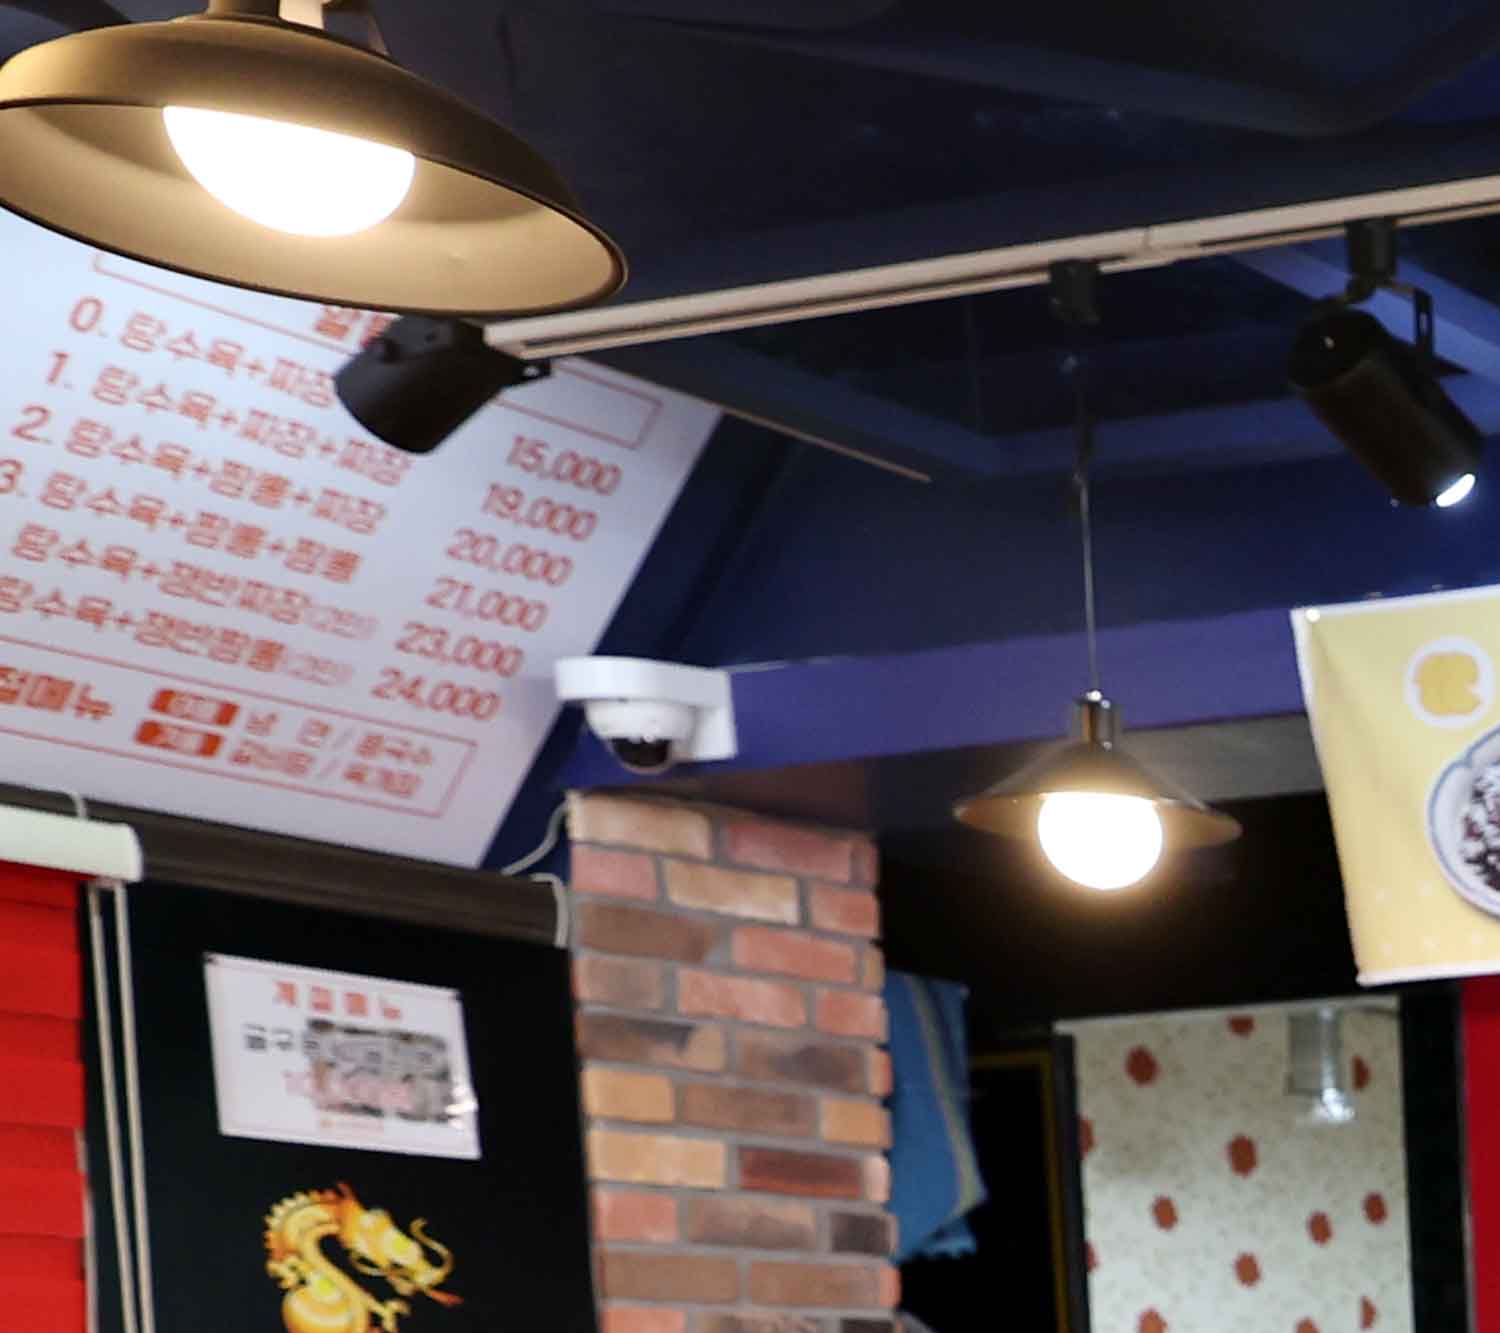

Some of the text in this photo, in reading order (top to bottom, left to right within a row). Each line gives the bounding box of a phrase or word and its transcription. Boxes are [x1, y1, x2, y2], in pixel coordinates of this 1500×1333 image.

[507, 434, 623, 496] 15,000
[446, 527, 574, 587] 20,000
[423, 575, 549, 633] 21,000
[394, 620, 525, 678] 23,000
[370, 666, 501, 721] 24,000
